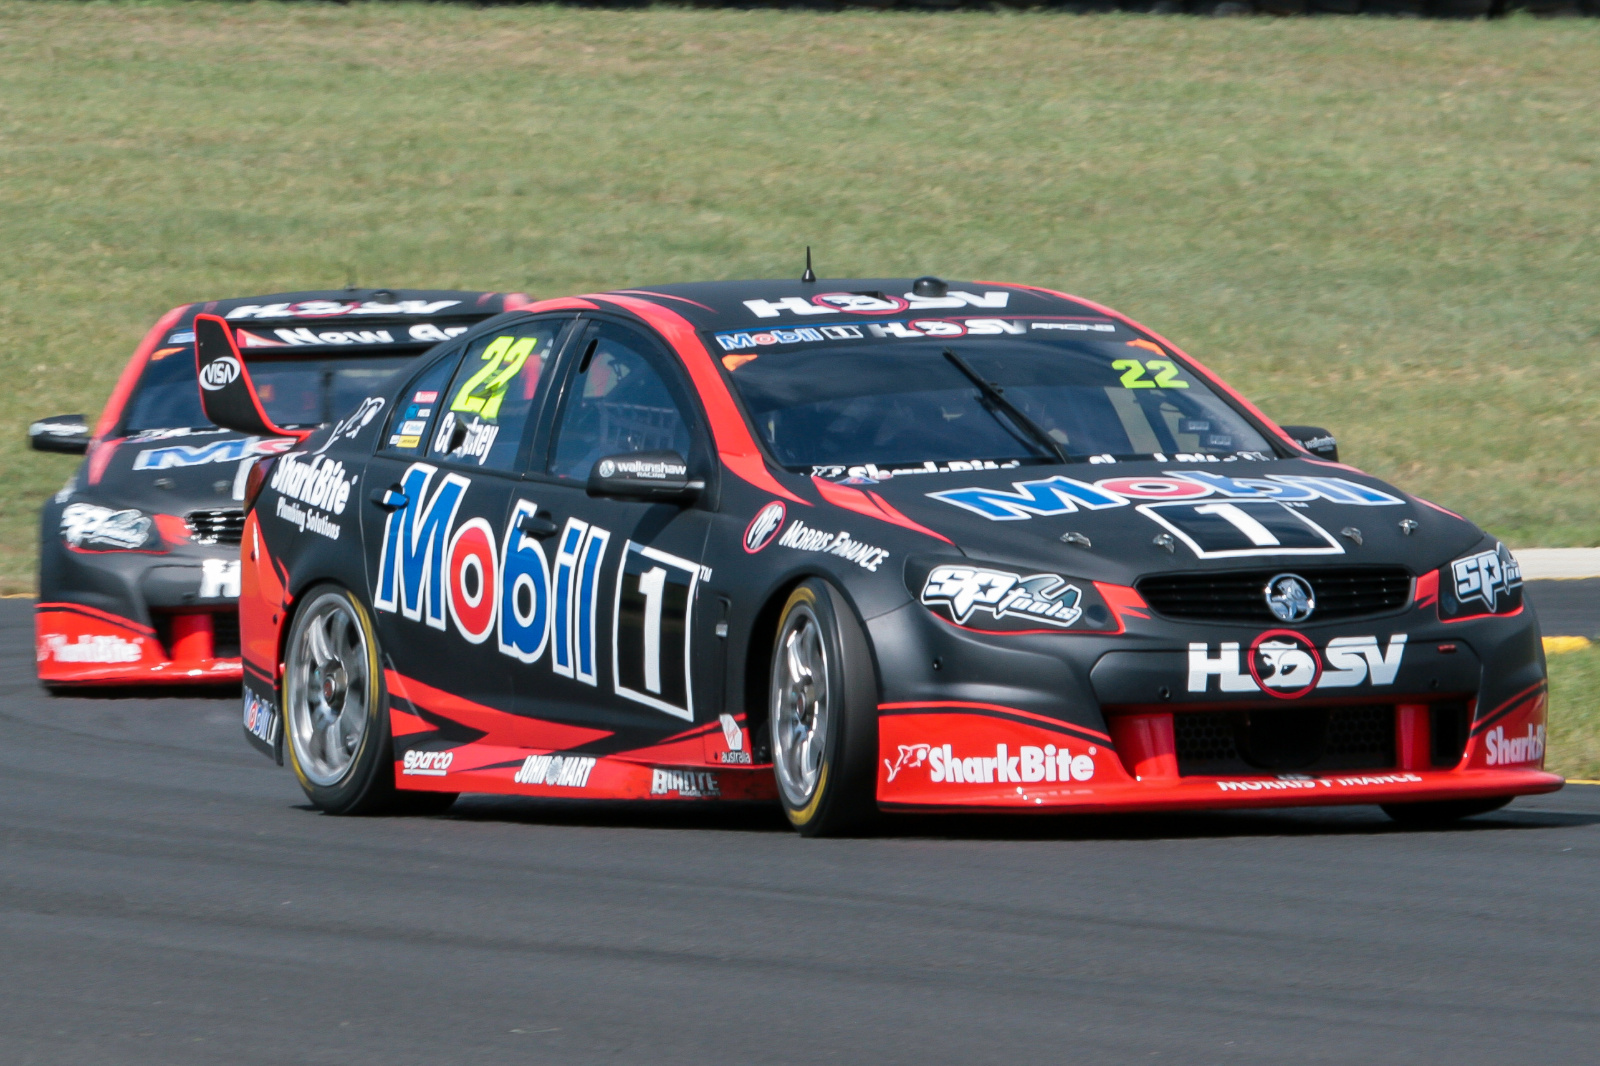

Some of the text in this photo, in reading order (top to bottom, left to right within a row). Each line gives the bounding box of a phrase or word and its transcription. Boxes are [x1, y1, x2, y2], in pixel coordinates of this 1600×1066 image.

[716, 328, 825, 350] Mobil
[1031, 322, 1116, 333] RACING
[450, 336, 537, 419] 22
[1111, 359, 1190, 388] 22
[270, 453, 351, 515] SharkBite
[617, 460, 687, 475] walkinshaw
[924, 469, 1407, 522] Mobil
[276, 496, 341, 541] Plumbing Solutions
[374, 461, 611, 688] Mobil
[924, 568, 1081, 621] SP tools
[1454, 553, 1503, 606] SP
[403, 749, 454, 771] sparco
[514, 755, 597, 788] JOHN HART
[721, 751, 752, 764] australia
[928, 743, 1095, 784] SharkBite
